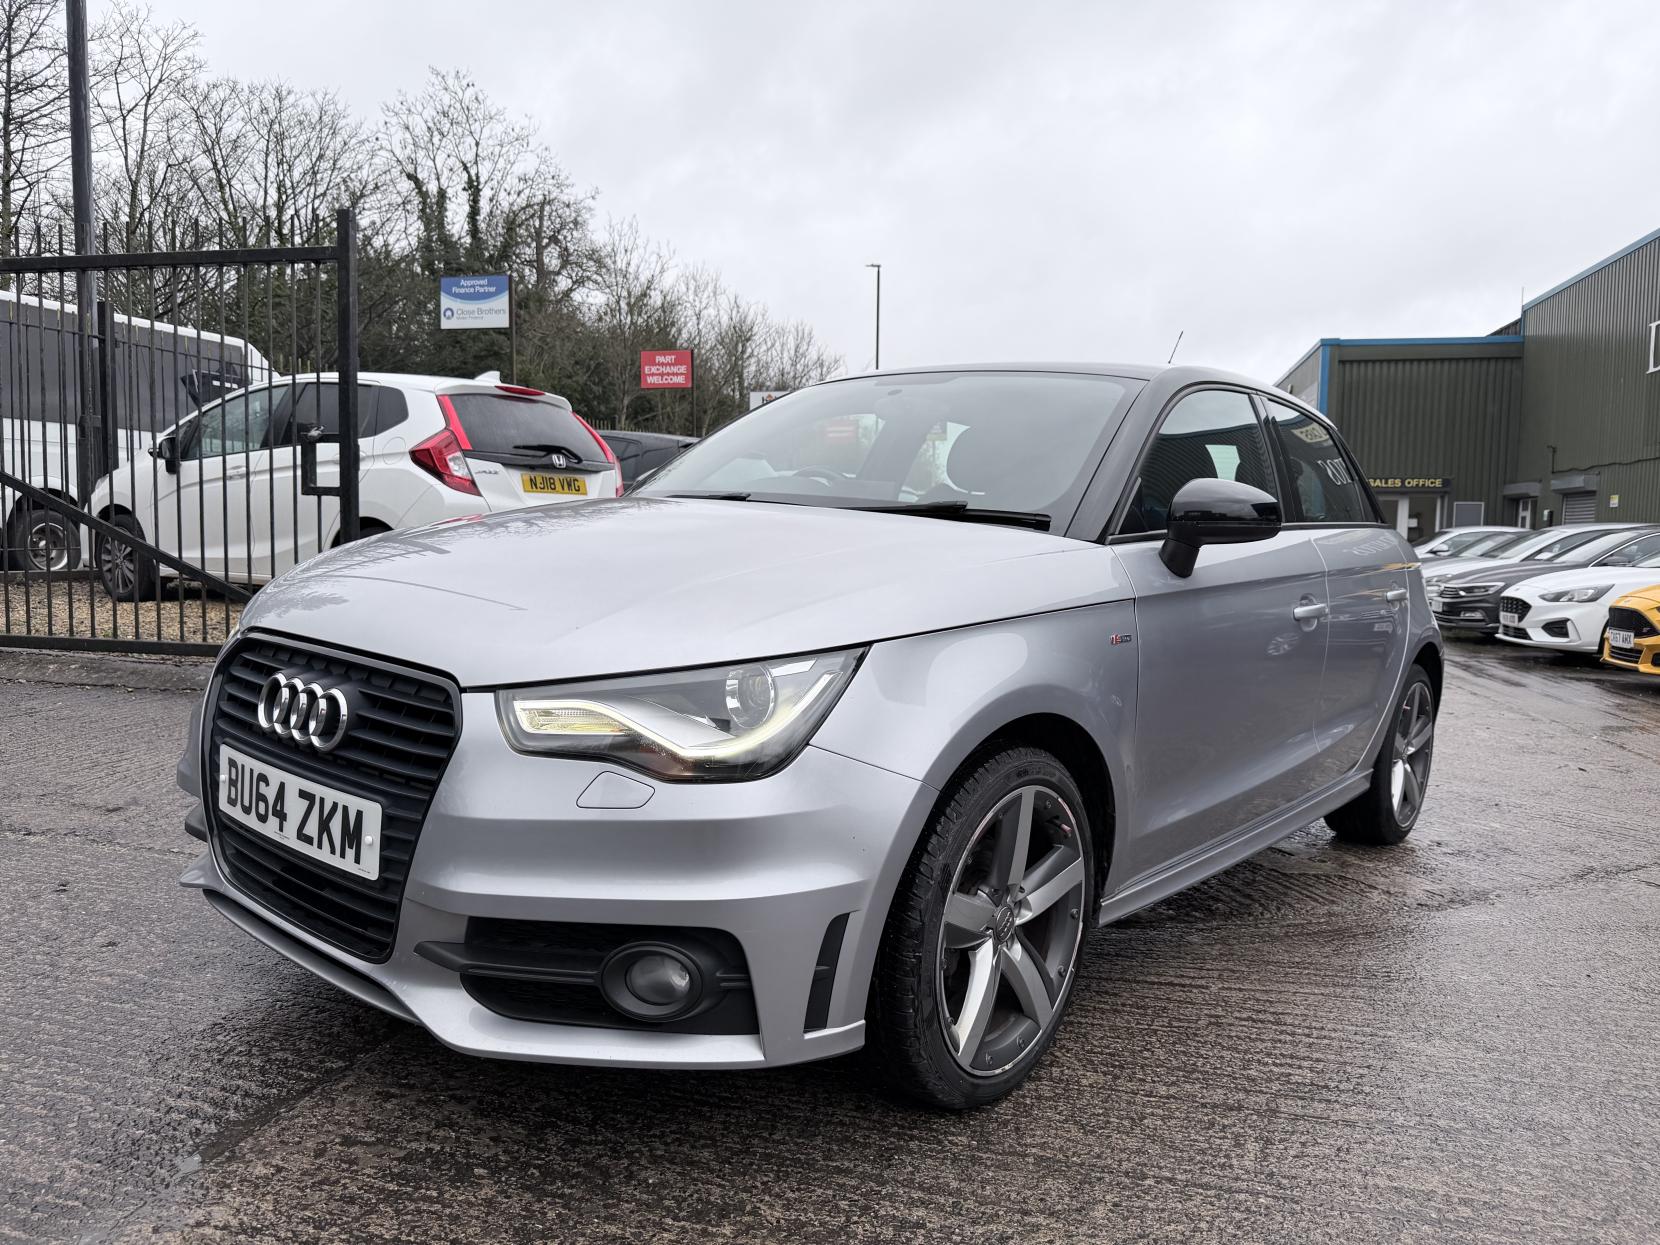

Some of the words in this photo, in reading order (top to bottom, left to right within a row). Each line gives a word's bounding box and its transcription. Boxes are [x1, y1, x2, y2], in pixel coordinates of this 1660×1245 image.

[460, 278, 488, 286] Approved
[456, 307, 476, 316] Close
[477, 307, 506, 316] Brothers
[655, 355, 676, 363] PART
[645, 365, 687, 374] EXCHANGE
[646, 375, 686, 384] WELCOME
[529, 475, 556, 490] NJ18
[558, 477, 581, 492] VWG
[1368, 478, 1402, 488] SALES
[1404, 478, 1443, 488] OFFICE
[227, 756, 287, 833] BU64
[296, 788, 364, 865] ZKM
